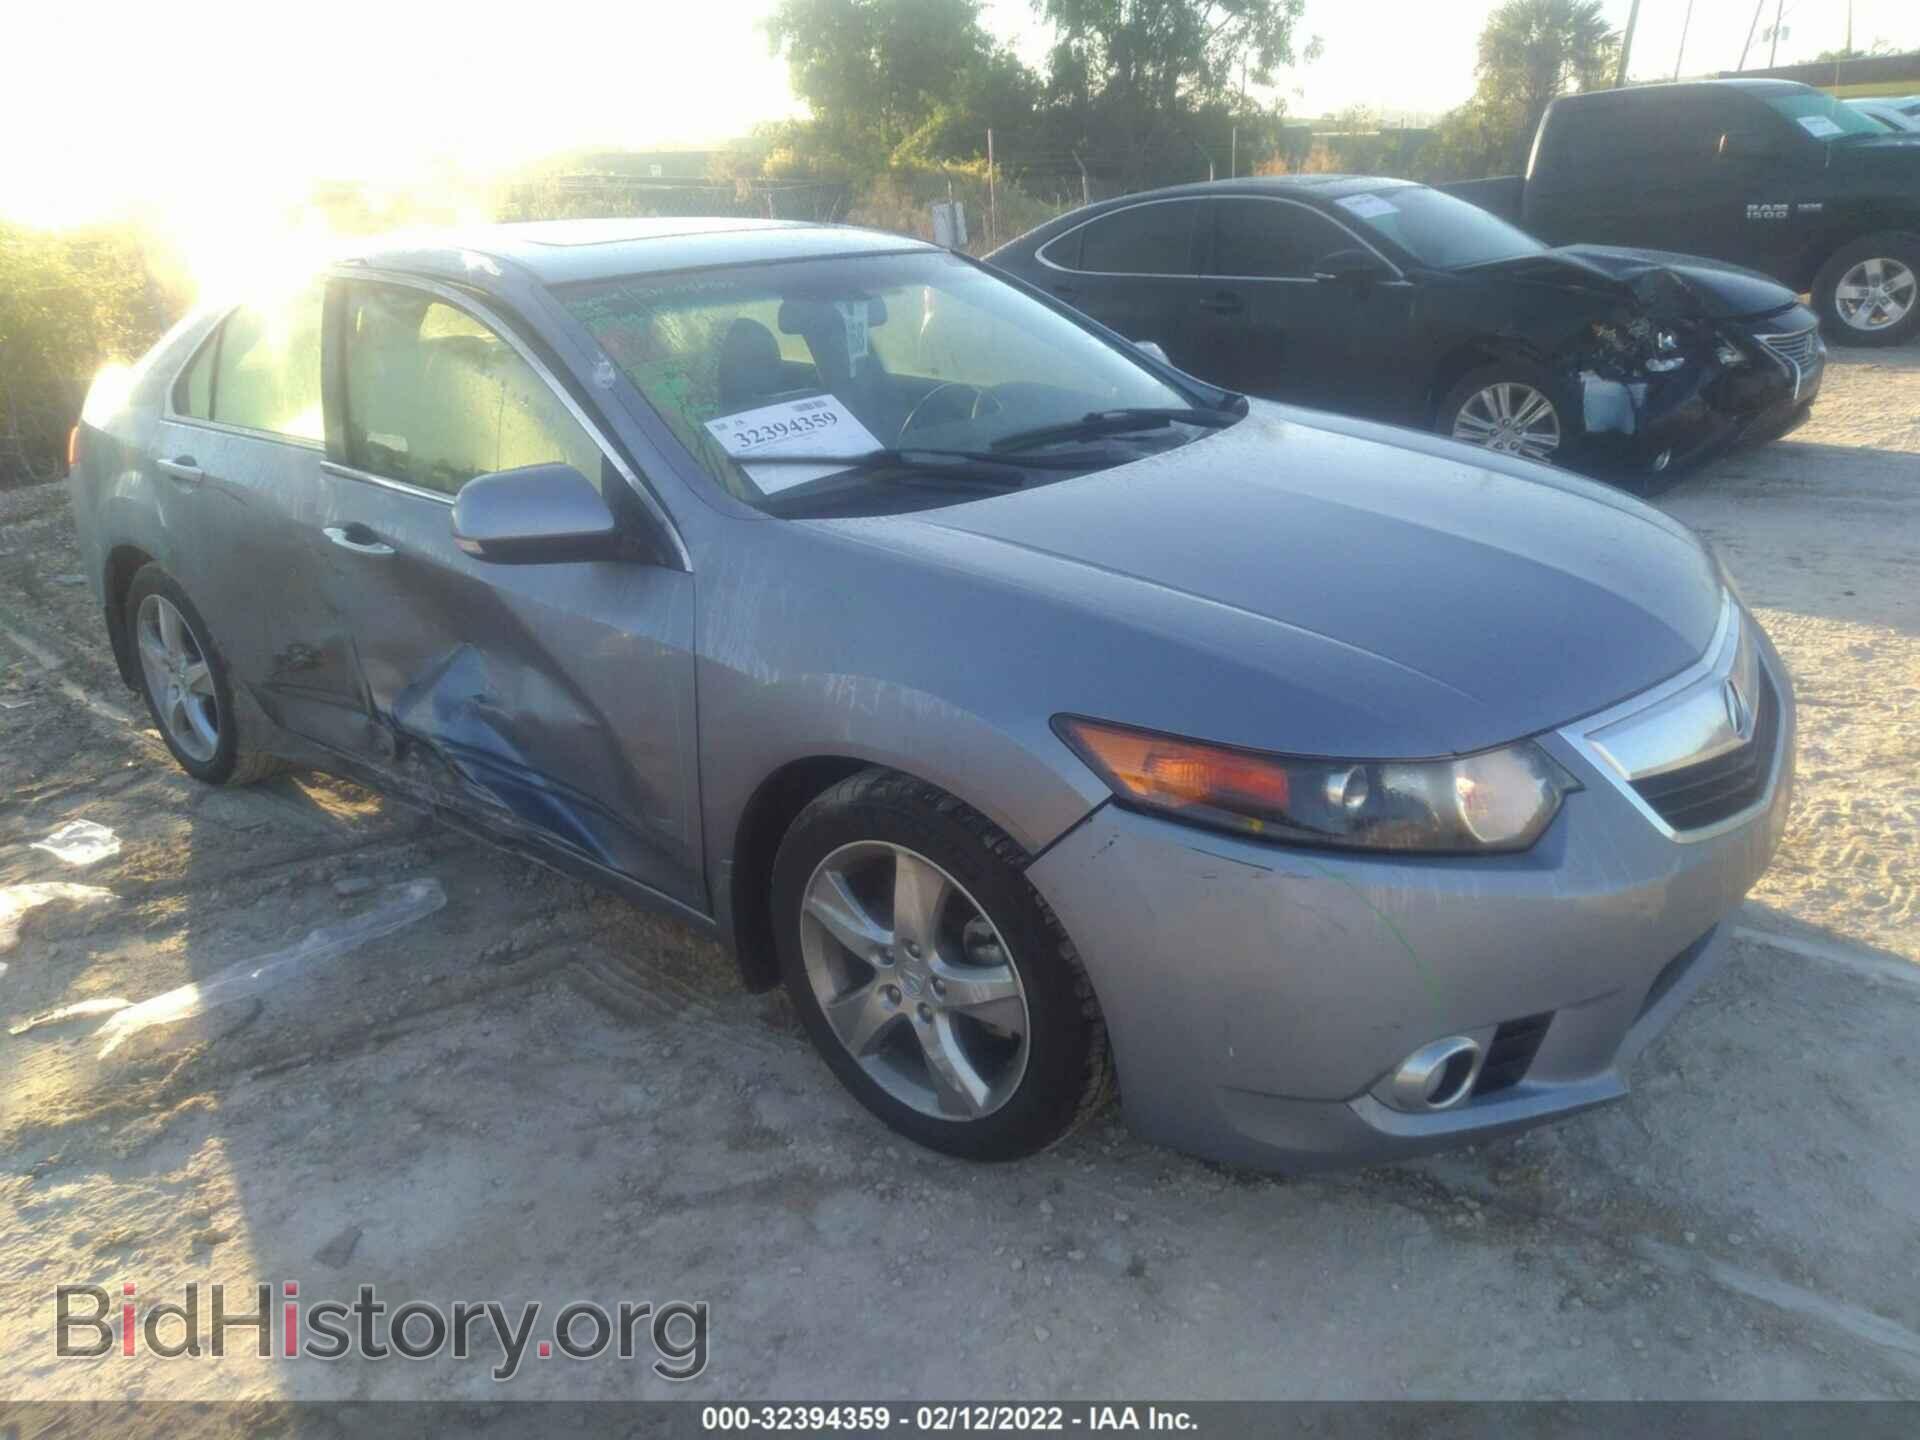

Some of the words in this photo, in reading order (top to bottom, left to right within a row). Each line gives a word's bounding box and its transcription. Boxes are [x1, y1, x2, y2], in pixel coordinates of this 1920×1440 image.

[1746, 203, 1789, 211] RAM
[1746, 211, 1788, 219] 1500
[734, 411, 838, 448] 32394359
